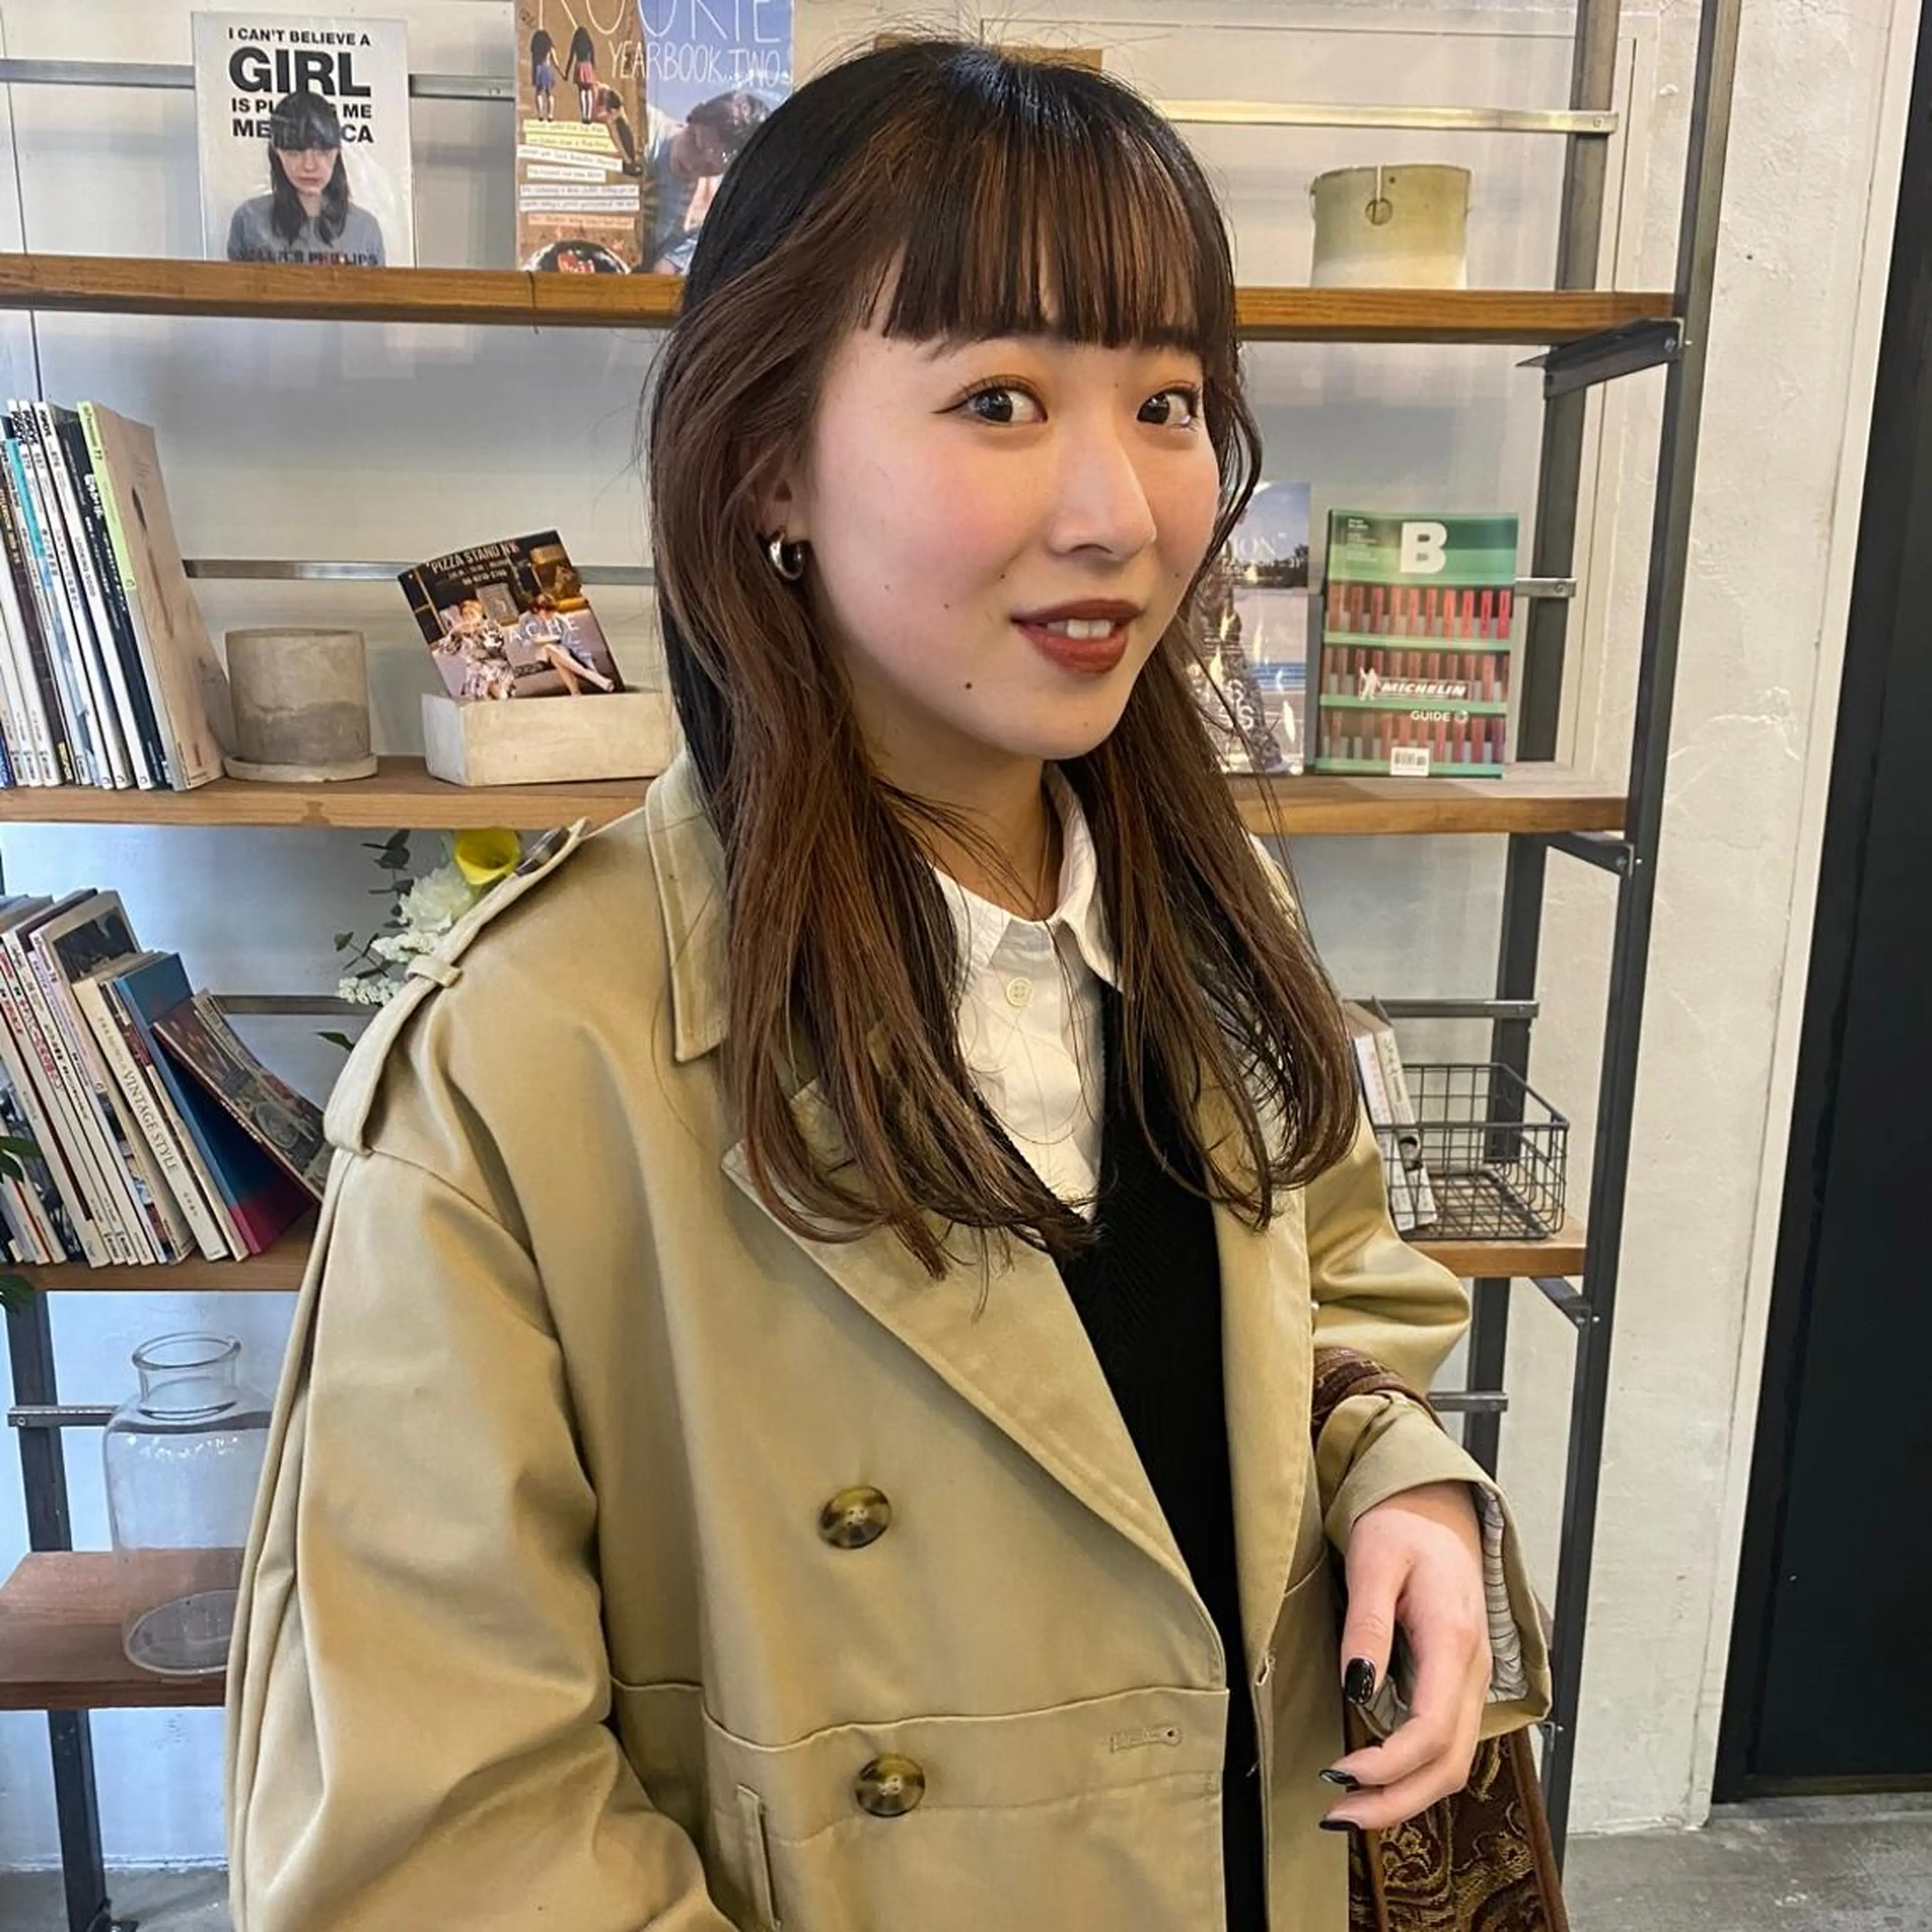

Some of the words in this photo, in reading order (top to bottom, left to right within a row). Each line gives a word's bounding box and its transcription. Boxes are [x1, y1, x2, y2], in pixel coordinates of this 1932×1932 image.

[229, 27, 233, 40] I
[237, 28, 285, 42] CAN'T
[290, 31, 356, 46] BELIEVE
[360, 34, 370, 46] A
[229, 46, 371, 98] GIRL
[608, 40, 722, 83] YEARBOOK
[728, 48, 780, 88] TWO
[231, 98, 251, 113] IS
[343, 104, 372, 119] ME
[431, 554, 465, 575] PIZZA
[463, 544, 501, 565] STAND
[1400, 522, 1447, 574] B
[1381, 682, 1467, 695] MICHELIN
[1410, 710, 1451, 722] GUIDE
[122, 1069, 159, 1130] VINTAGE
[151, 1126, 179, 1173] STYLE
